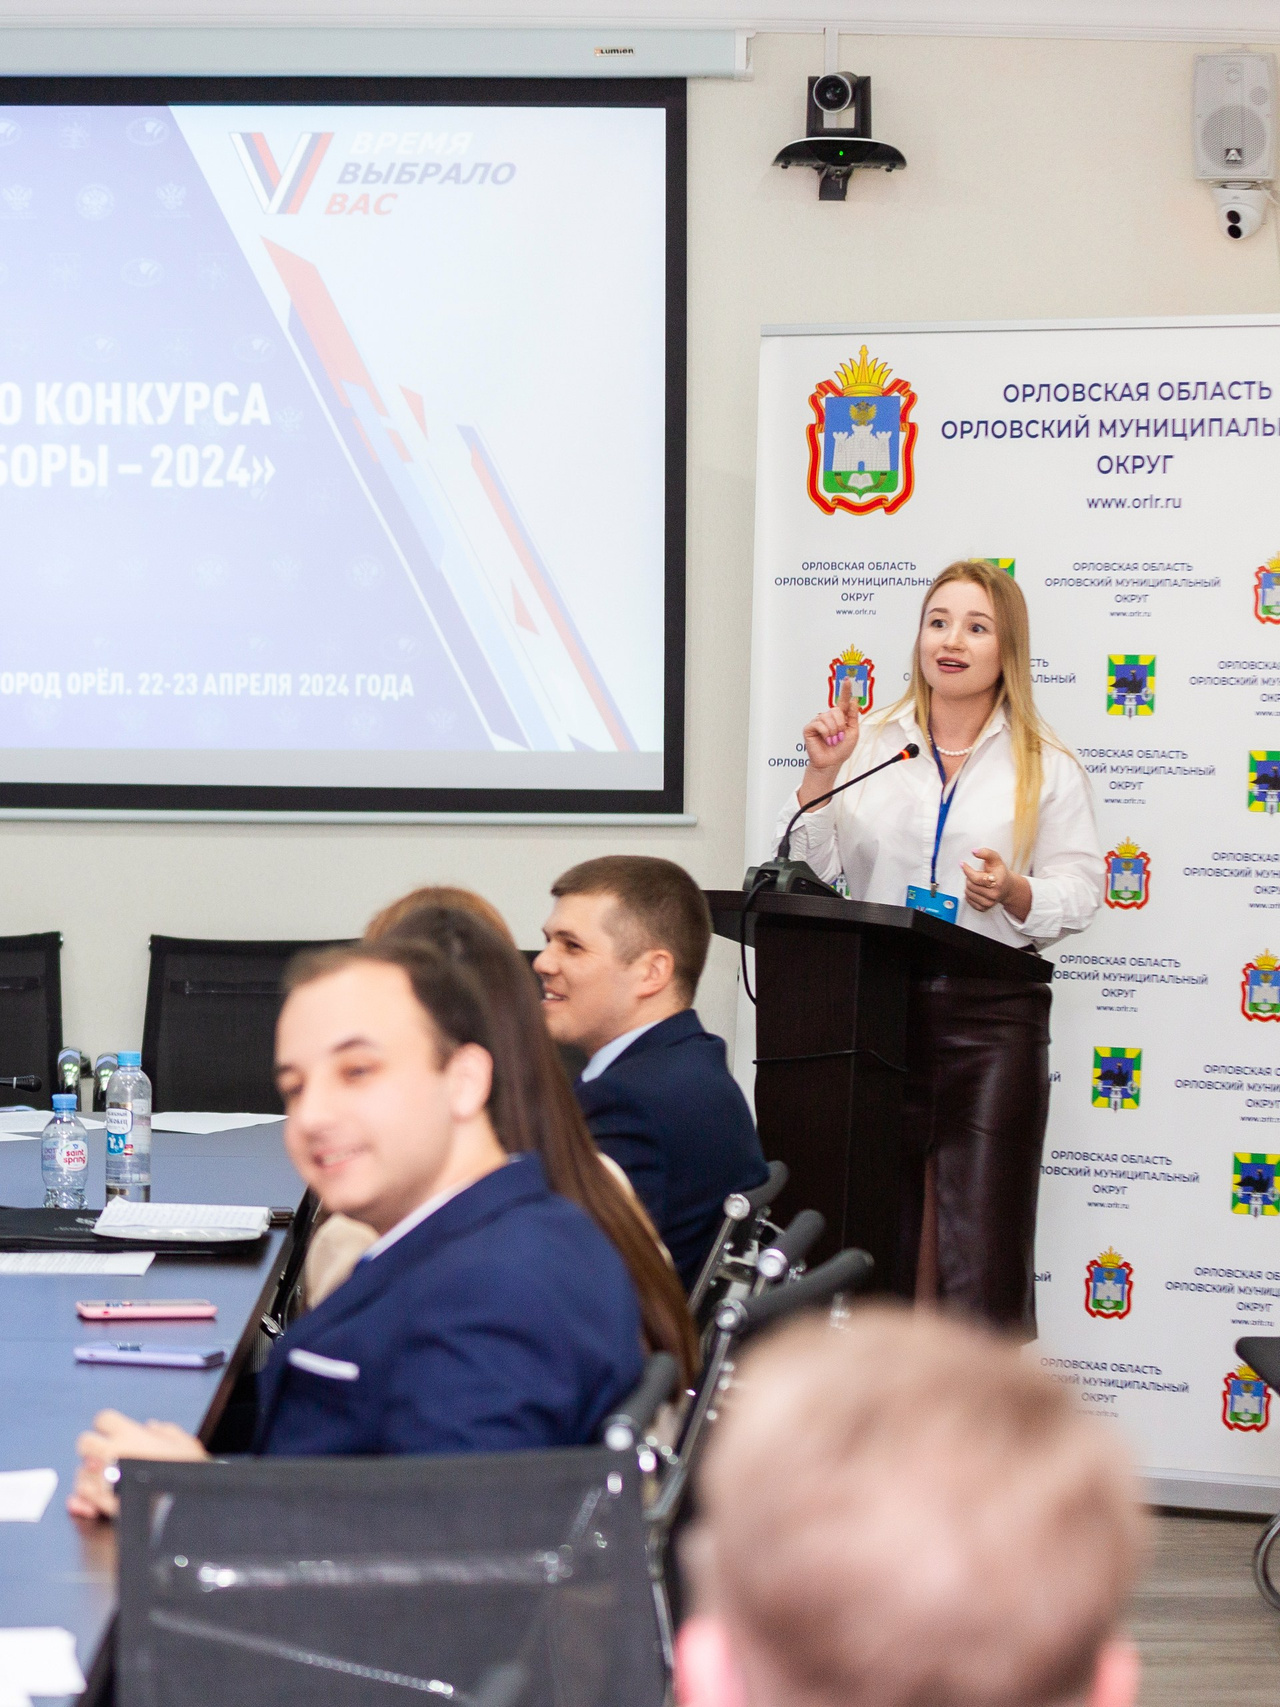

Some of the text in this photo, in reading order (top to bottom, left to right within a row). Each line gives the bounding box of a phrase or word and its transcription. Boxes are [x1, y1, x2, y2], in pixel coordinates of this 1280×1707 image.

[350, 131, 474, 156] ВРЕМЯ
[336, 162, 517, 185] ВЫБРАЛО
[323, 193, 398, 215] ВАС
[1003, 380, 1273, 403] ОРЛОВСКАЯ ОБЛАСТЬ
[35, 381, 271, 426] КОНКУРСА
[941, 414, 1090, 440] ОРЛОВСКИЙ
[150, 444, 276, 488] 2024»
[1096, 454, 1174, 475] ОКРУГ
[1086, 494, 1182, 510] www.orlr.ru
[801, 561, 917, 571] ОРЛОВСКАЯ ОБЛАСТЬ
[1073, 562, 1193, 572] ОРЛОВСКАЯ ОБЛАСТЬ
[774, 574, 934, 588] ОРЛОВСКИЙ МУНИЦИПАЛЬНЫ
[1044, 576, 1221, 588] ОРЛОВСКИЙ МУНИЦИПАЛЬНЫЙ
[840, 592, 875, 602] ОКРУГ
[1114, 594, 1149, 603] ОКРУГ
[835, 608, 876, 616] www.orlr.ru
[1218, 660, 1280, 670] ОРЛОВСКА
[66, 667, 133, 696] ОРЁЛ.
[138, 672, 198, 696] 22-23
[202, 673, 292, 697] АПРЕЛЯ
[299, 674, 350, 697] 2024
[355, 674, 415, 701] ГОДА
[1189, 674, 1258, 686] ОРЛОВСКИЙ
[1136, 749, 1189, 760] ОБЛАСТЬ
[1110, 764, 1217, 777] МУНИЦИПАЛЬНЫЙ
[1109, 781, 1145, 790] ОКРУГ
[1183, 866, 1252, 878] ОРЛОВСКИЙ
[1059, 954, 1181, 968] ОРЛОВСКАЯ ОБЛАСТЬ
[1053, 969, 1208, 986] ОВСКИЙ МУНИЦИПАЛЬНЫЙ
[1101, 988, 1137, 998] ОКРУГ
[1204, 1064, 1272, 1076] ОРЛОВСКАЯ
[1175, 1079, 1244, 1091] ОРЛОВСКИЙ
[1051, 1150, 1173, 1166] ОРЛОВСКАЯ ОБЛАСТЬ
[1094, 1168, 1200, 1183] МУНИЦИПАЛЬНЫЙ
[1092, 1184, 1128, 1195] ОКРУГ
[1194, 1266, 1263, 1280] ОРЛОВСКАЯ
[1165, 1281, 1235, 1294] ОРЛОВСКИЙ
[1236, 1301, 1273, 1312] ОКРУГ
[1040, 1357, 1162, 1376] ОРЛОВСКАЯ ОБЛАСТЬ
[1082, 1376, 1190, 1394] МУНИЦИПАЛЬНЫЙ
[1081, 1391, 1118, 1404] ОКРУГ
